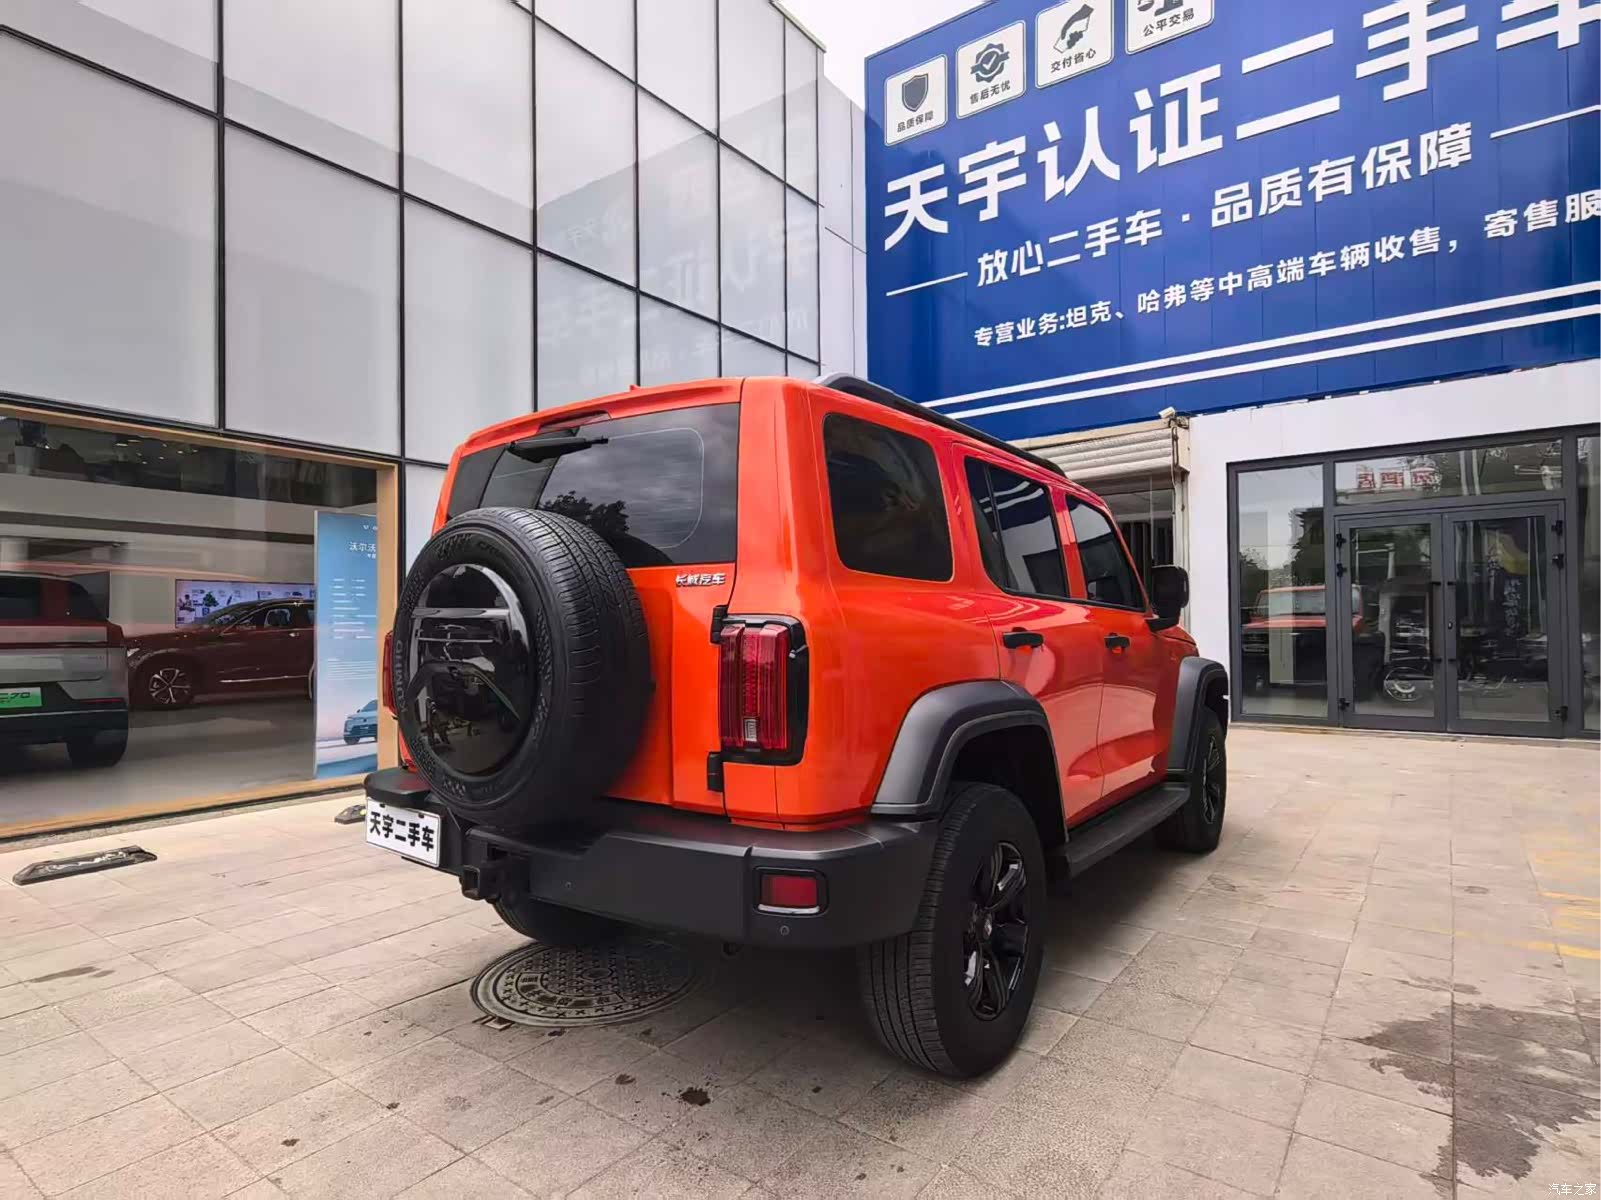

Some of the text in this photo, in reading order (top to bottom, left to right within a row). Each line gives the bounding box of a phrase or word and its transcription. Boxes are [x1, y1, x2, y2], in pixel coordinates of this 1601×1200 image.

[1143, 8, 1195, 37] 公平交易
[1050, 48, 1097, 73] 交付省心
[969, 80, 1011, 105] 售后无忧
[897, 111, 934, 133] 品质保障
[675, 572, 727, 587] 长城汽车
[369, 811, 435, 852] 天宇二手车
